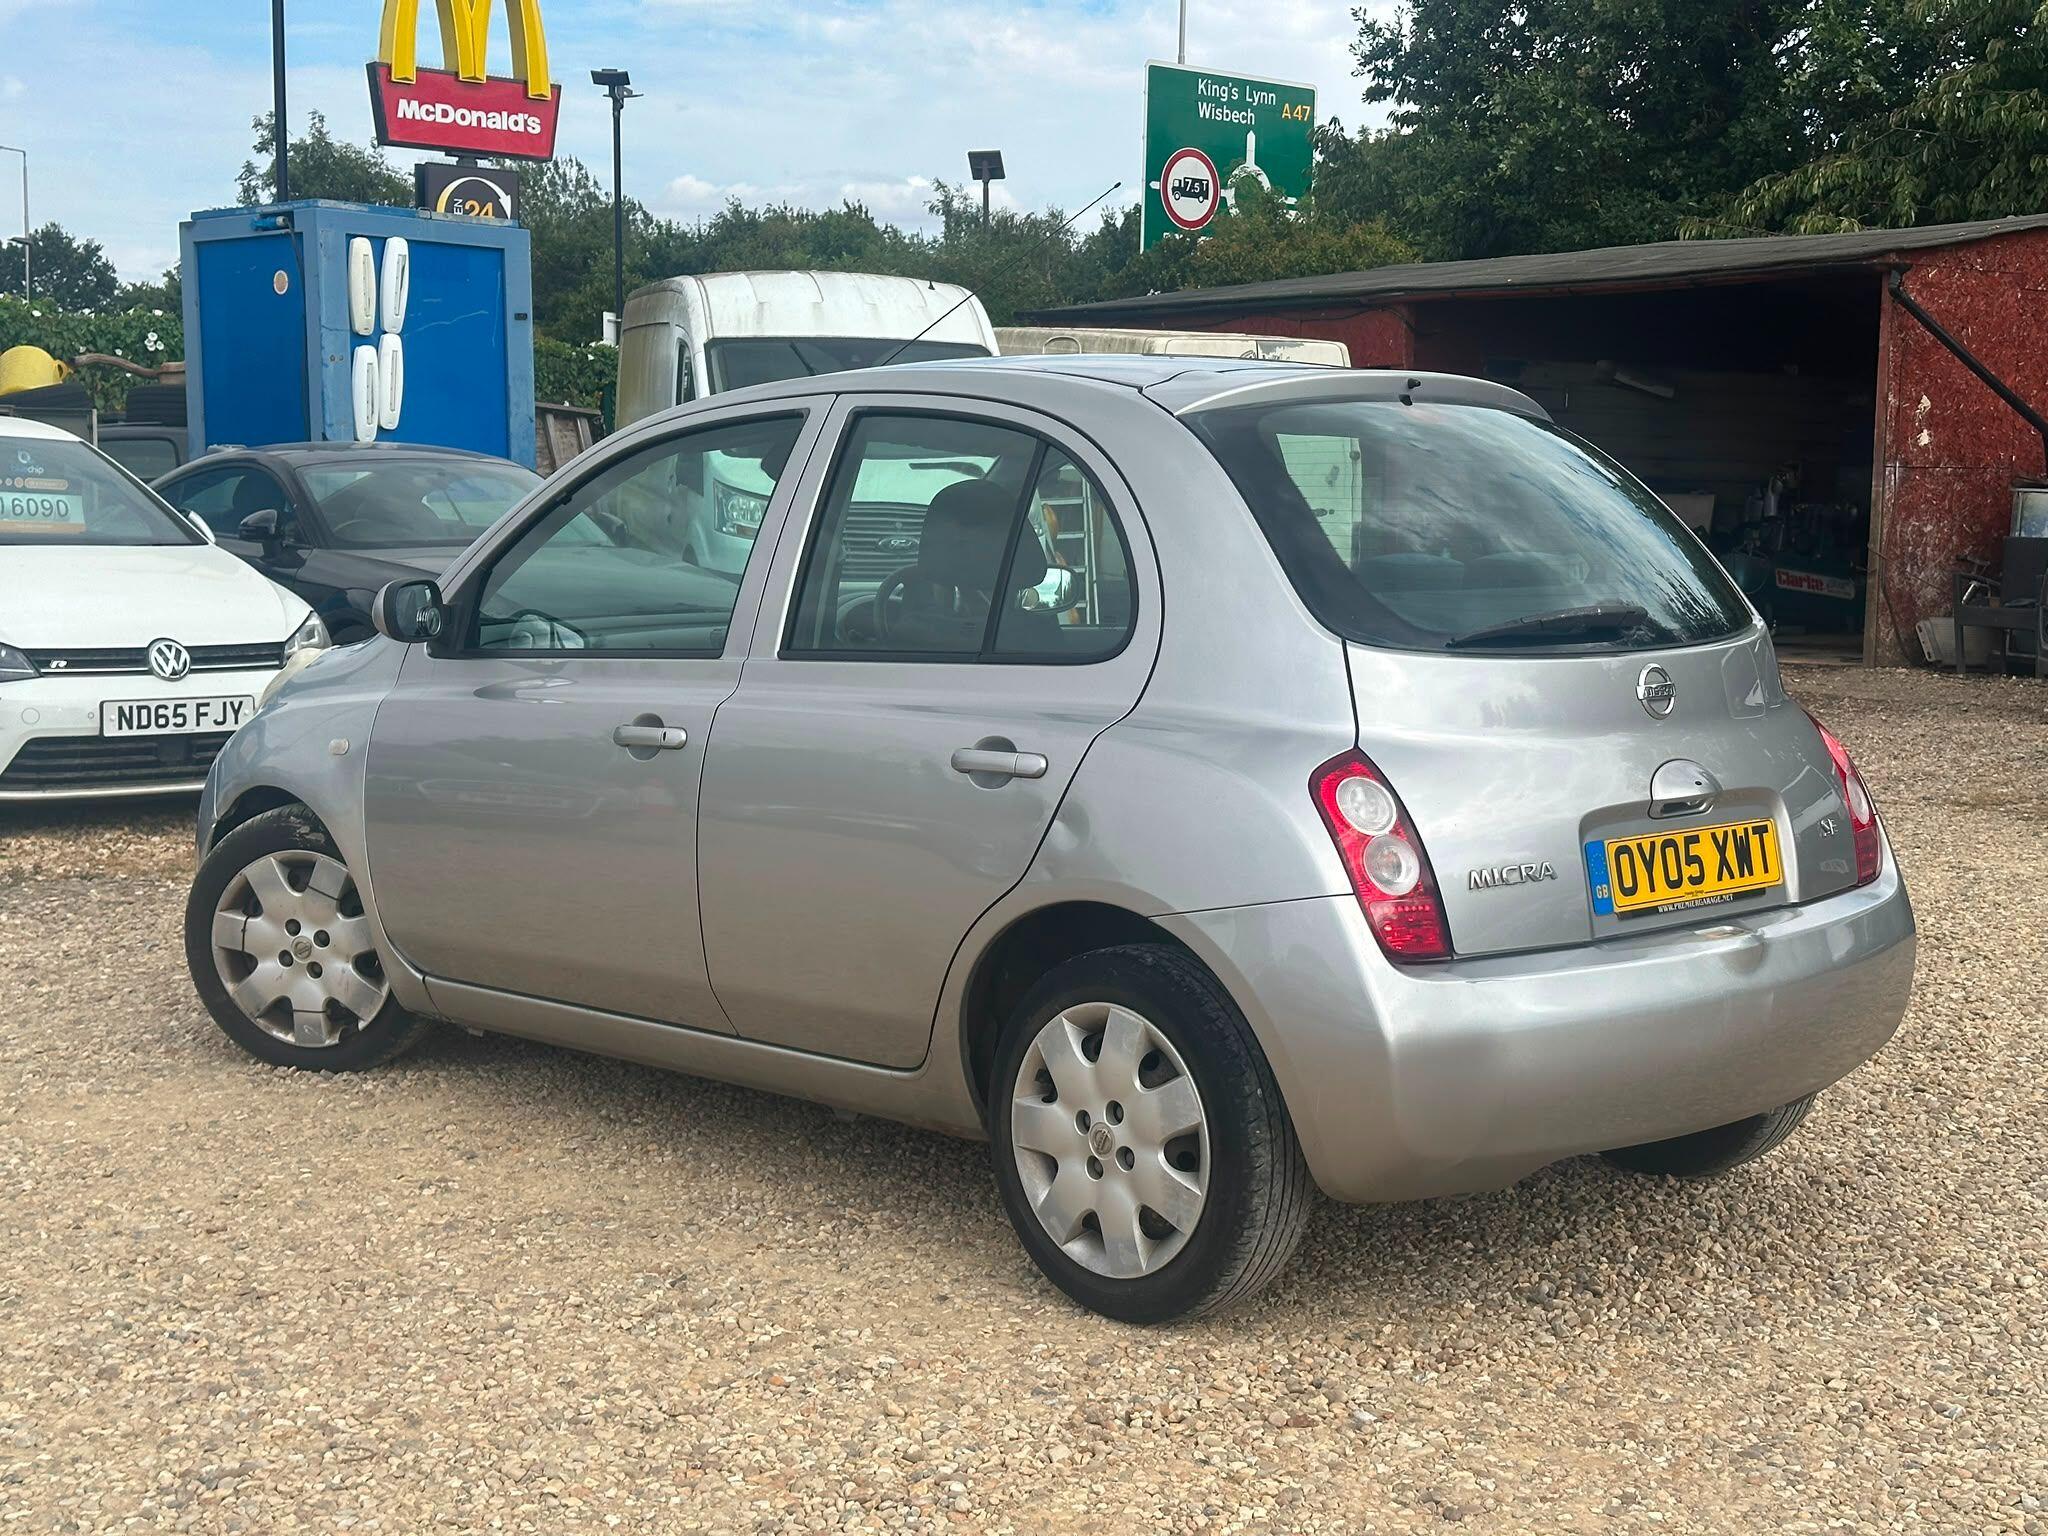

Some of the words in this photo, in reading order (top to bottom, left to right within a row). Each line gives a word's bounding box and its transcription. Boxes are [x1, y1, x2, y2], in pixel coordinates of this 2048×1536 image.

[1197, 78, 1239, 102] King's
[1245, 85, 1276, 106] Lynn
[397, 98, 542, 134] McDonald's
[1197, 101, 1255, 125] Wisbech
[1281, 102, 1311, 122] A47
[464, 199, 495, 218] 24
[1776, 568, 1825, 591] Clarke
[117, 702, 187, 731] ND65
[195, 700, 244, 727] FJY
[1614, 835, 1706, 898] OY05
[1711, 824, 1770, 882] XWT
[1469, 861, 1558, 891] MICRA
[1596, 884, 1609, 899] GB
